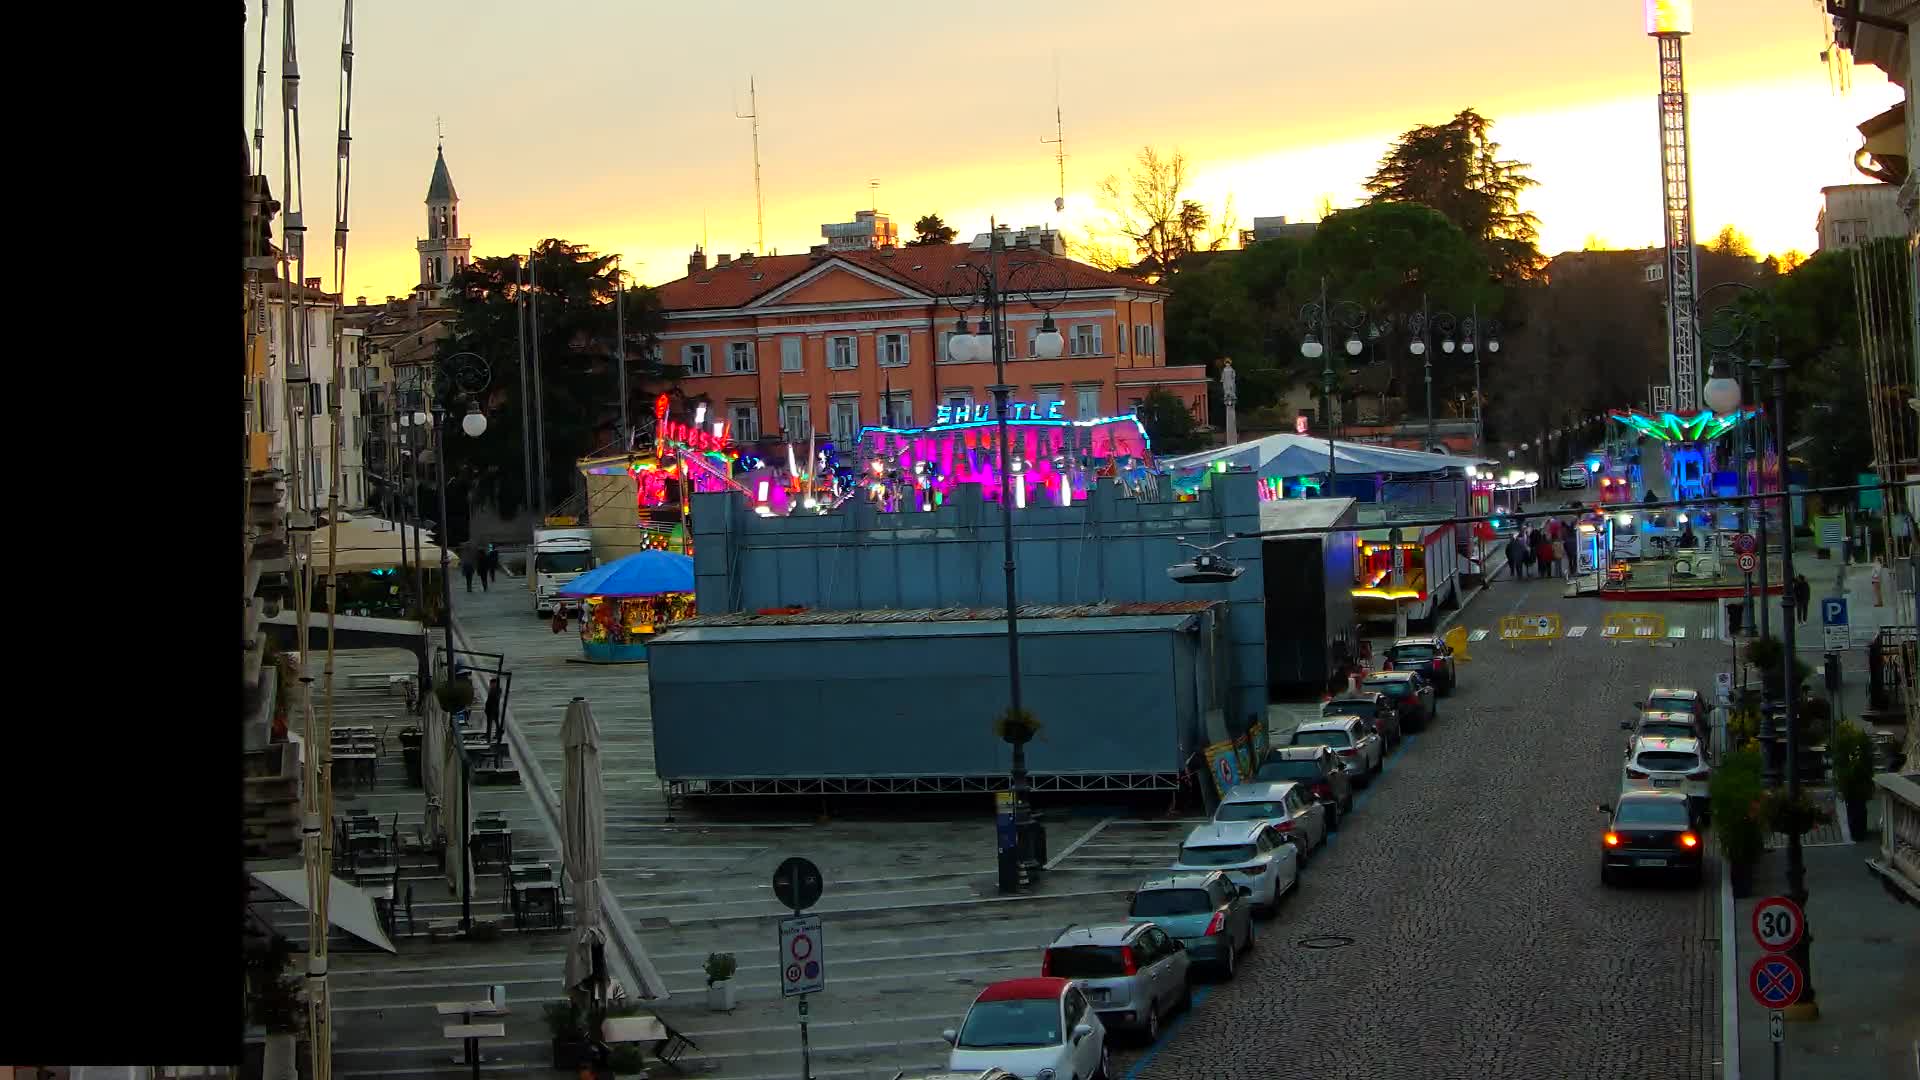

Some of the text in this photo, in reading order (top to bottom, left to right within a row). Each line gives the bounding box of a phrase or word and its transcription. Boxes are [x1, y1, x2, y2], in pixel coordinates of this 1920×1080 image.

[937, 400, 1065, 423] SHUTLE
[1742, 557, 1752, 567] 20
[1826, 602, 1842, 622] P
[1762, 912, 1792, 938] 30
